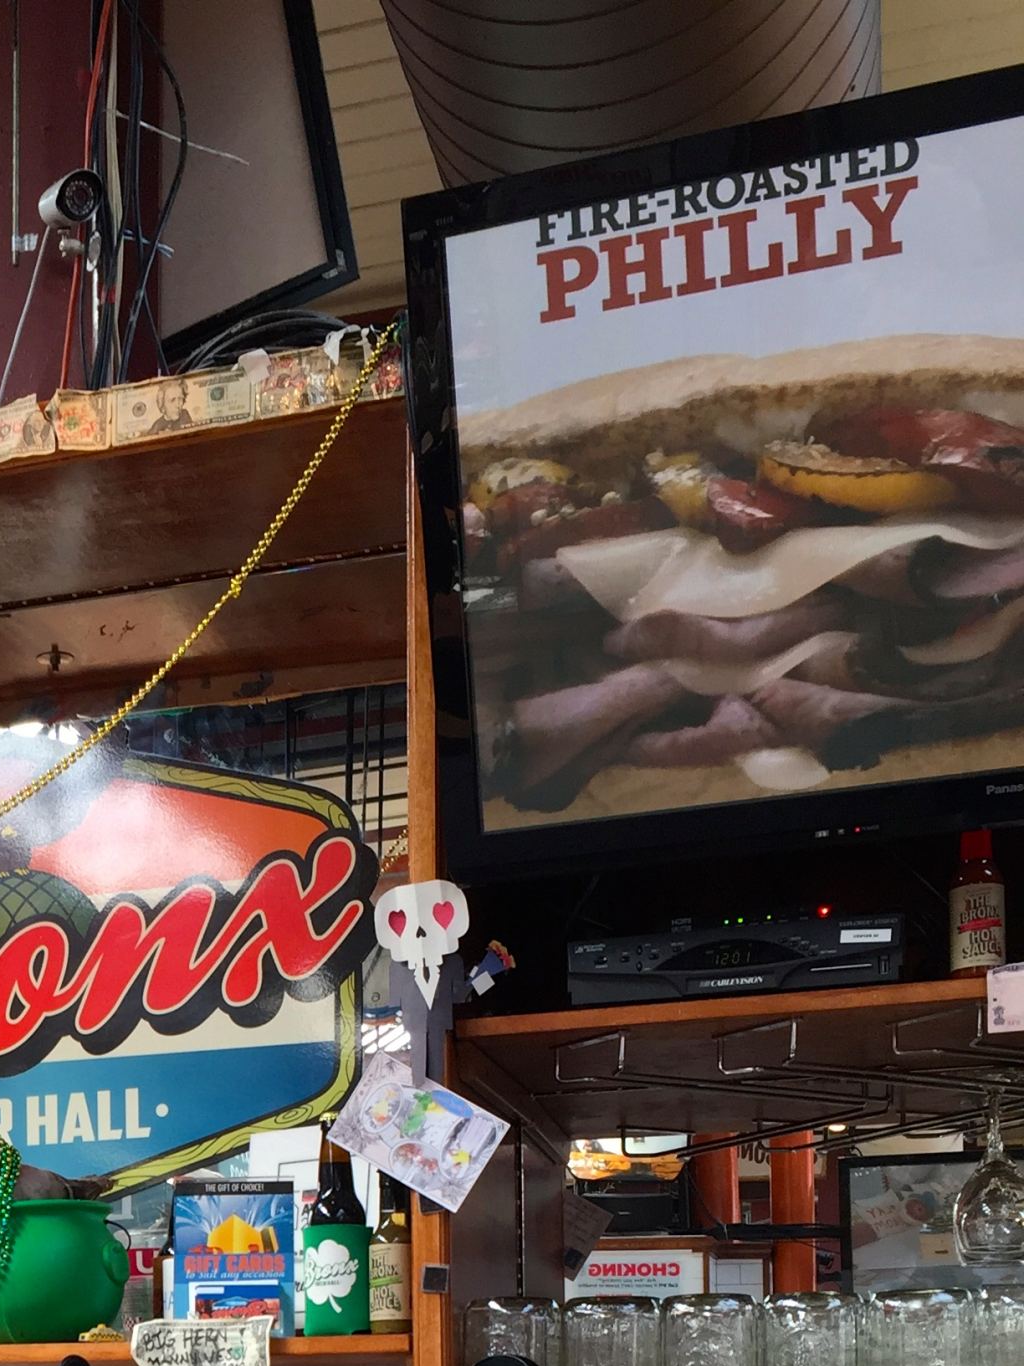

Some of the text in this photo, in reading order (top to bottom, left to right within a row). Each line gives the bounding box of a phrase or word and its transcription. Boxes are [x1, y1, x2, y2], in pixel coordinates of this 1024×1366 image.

[536, 137, 919, 247] FIRE-ROASTED
[537, 176, 918, 323] PHILLY
[710, 975, 764, 989] CABLEVISION
[26, 1087, 151, 1147] HALL
[205, 1183, 265, 1192] THE GIFT OF CHOICE!
[184, 1254, 285, 1274] GIFT CARDS
[185, 1270, 285, 1281] to suit any occasion
[305, 1257, 359, 1289] Bronx
